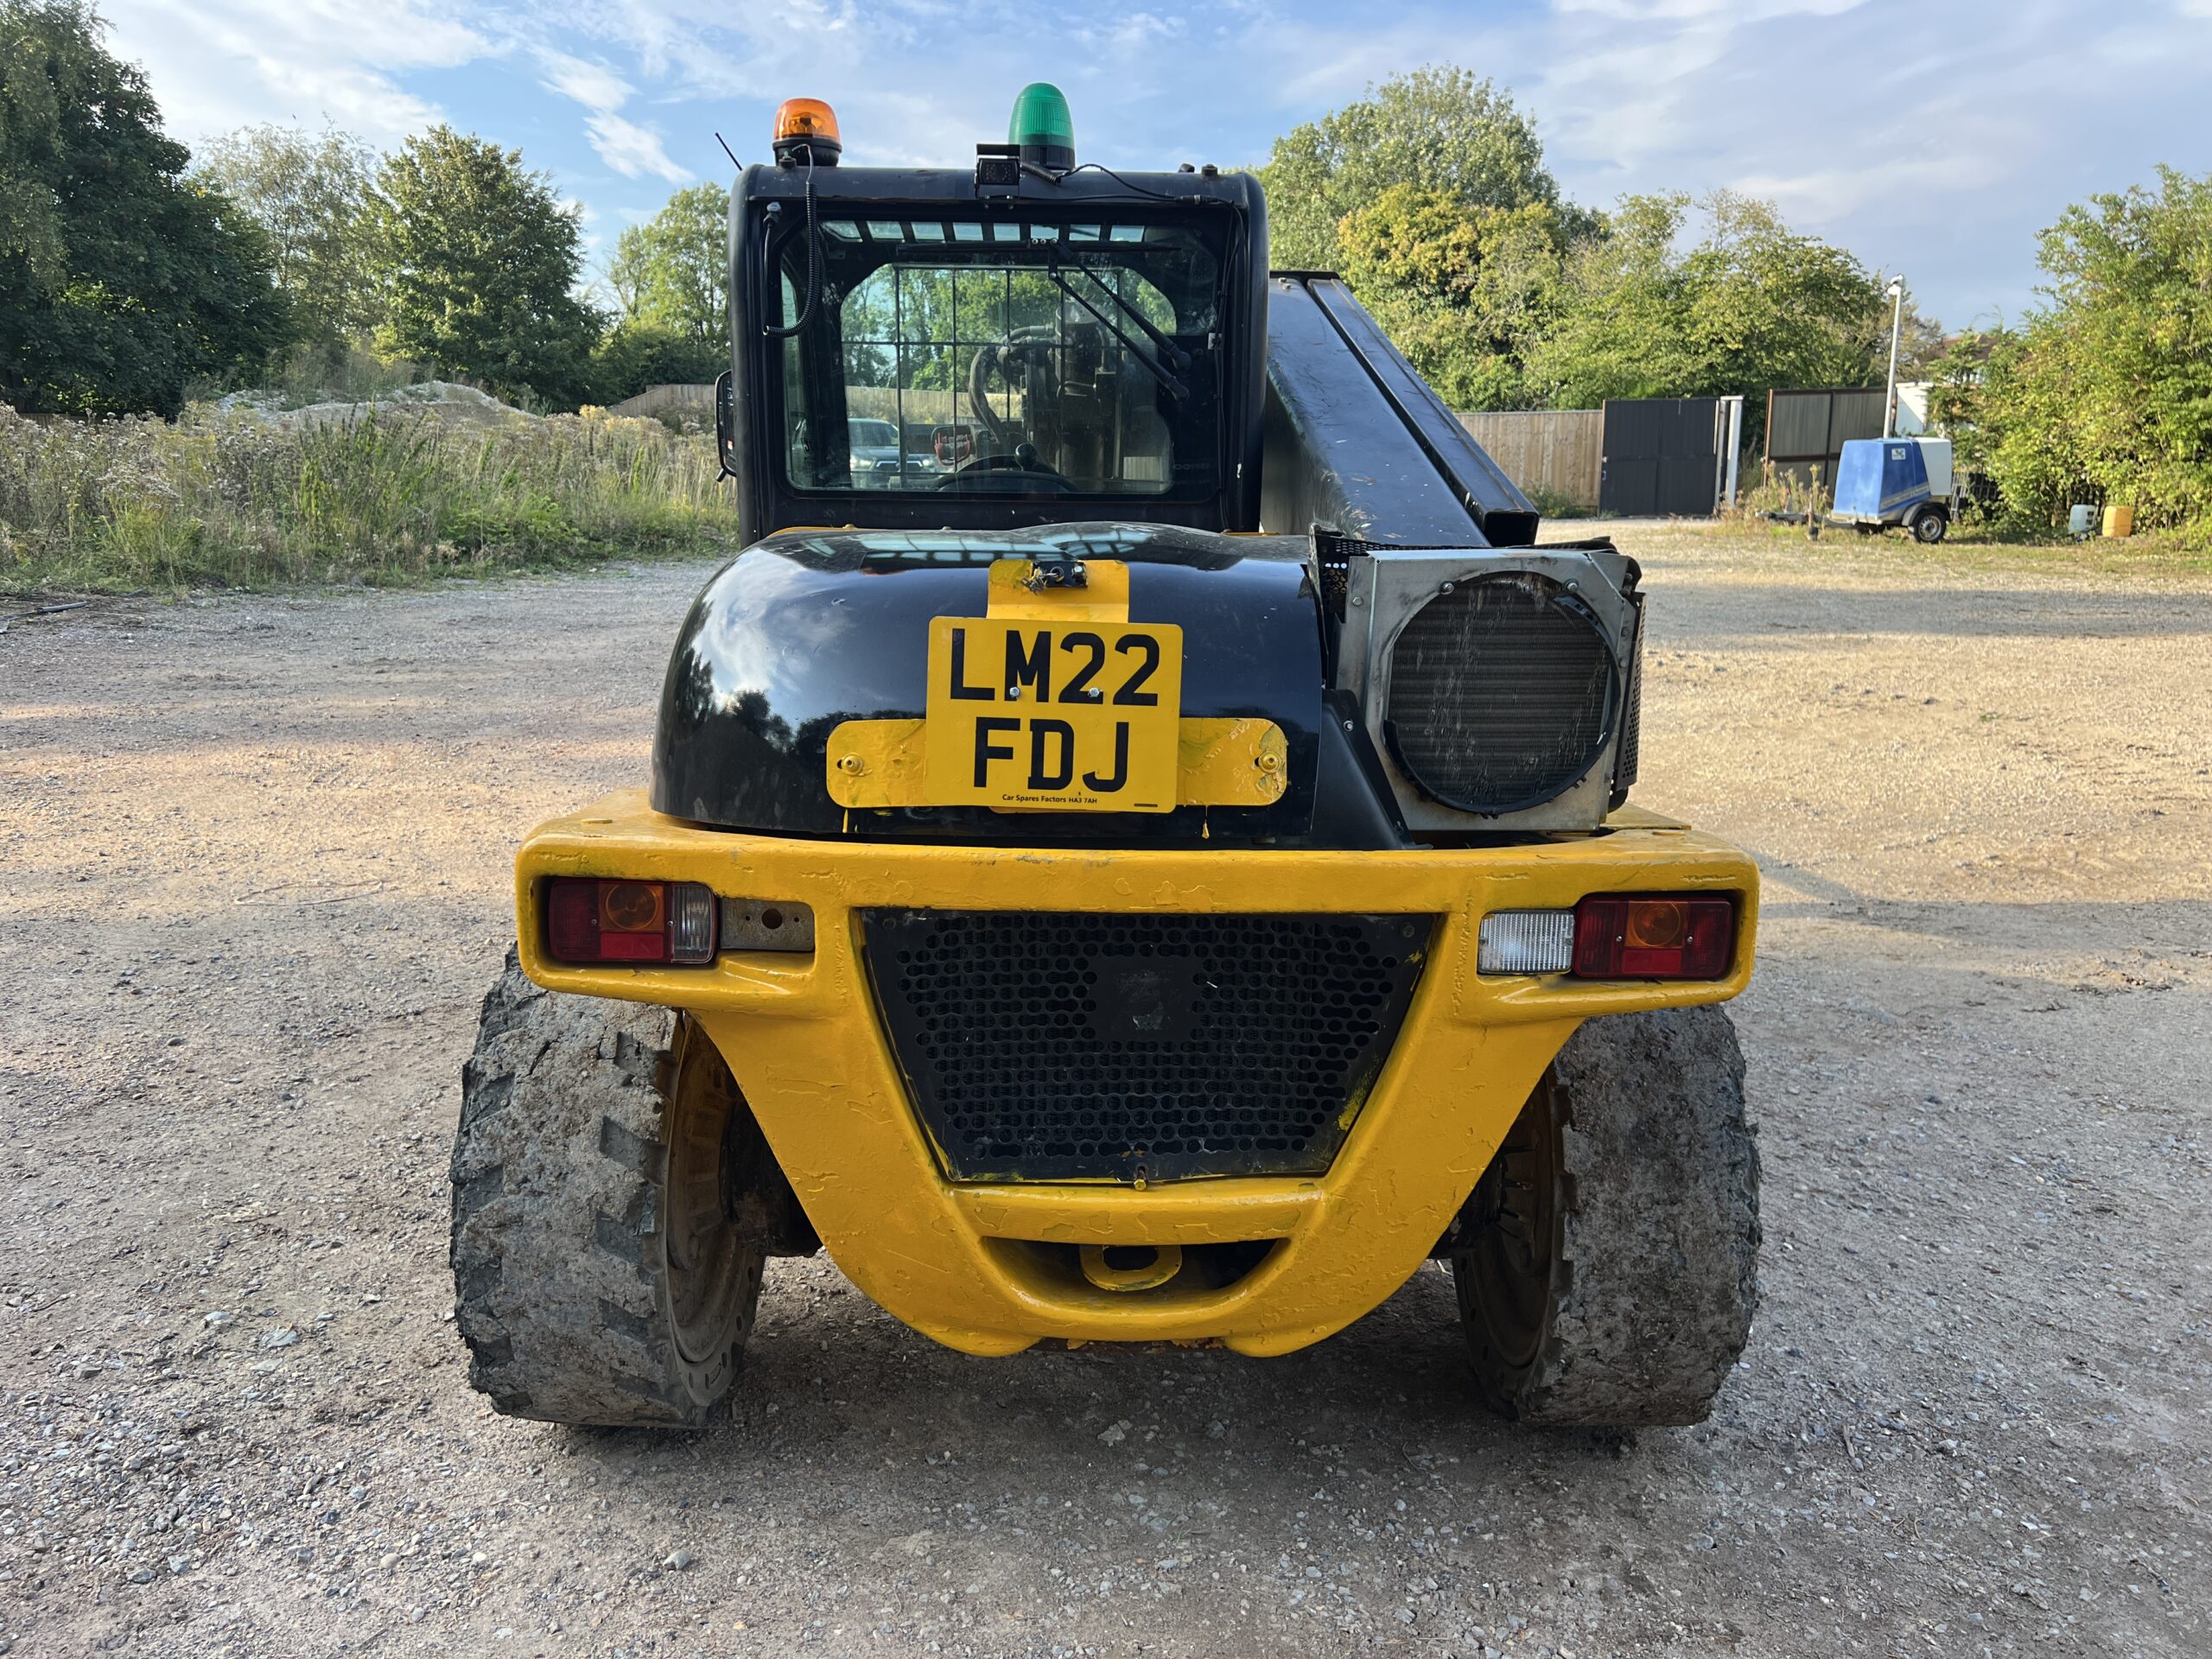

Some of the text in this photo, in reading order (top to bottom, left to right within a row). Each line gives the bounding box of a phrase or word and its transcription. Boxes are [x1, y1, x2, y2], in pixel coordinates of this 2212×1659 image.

[950, 628, 1160, 706] LM22
[974, 716, 1129, 792] FDJ
[1015, 794, 1039, 803] Spares
